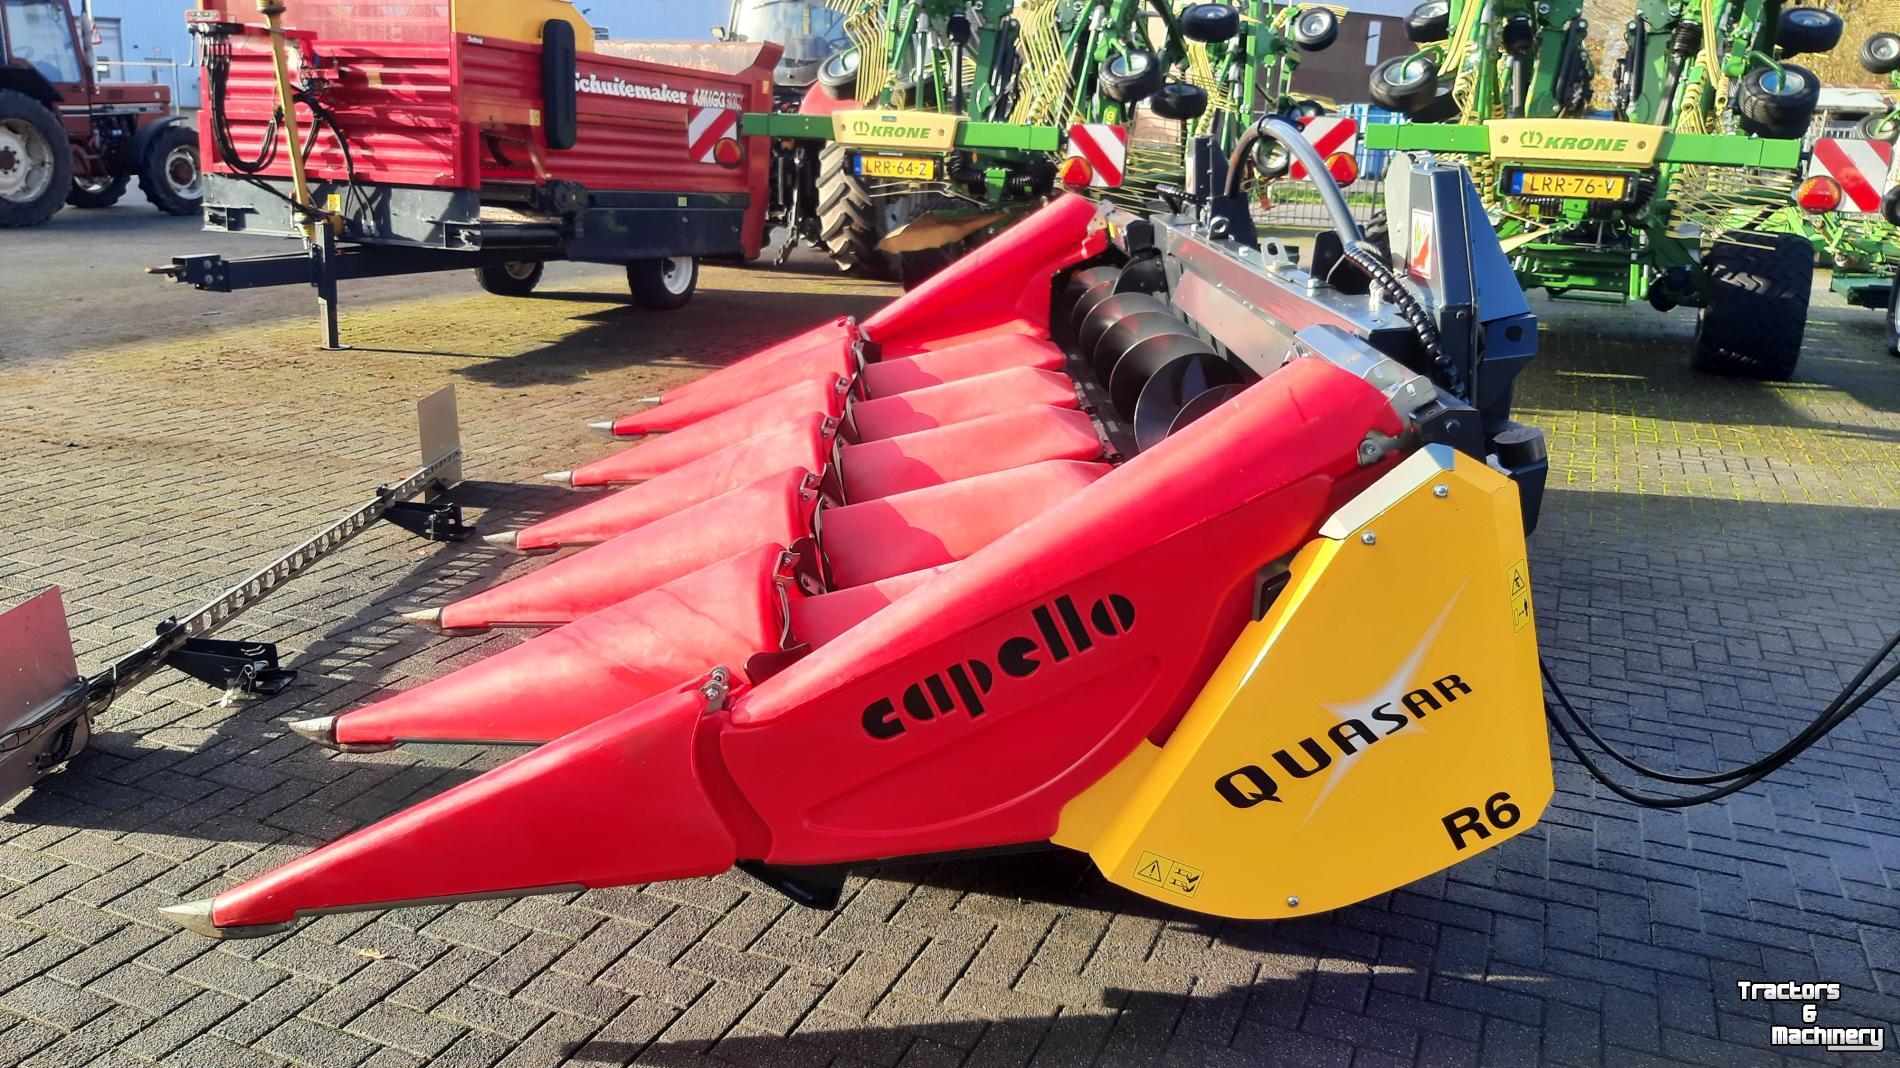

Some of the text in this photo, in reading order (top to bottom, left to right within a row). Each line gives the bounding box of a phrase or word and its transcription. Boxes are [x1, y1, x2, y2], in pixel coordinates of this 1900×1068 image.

[692, 88, 725, 107] AMIGO
[870, 125, 931, 139] KRONE
[1544, 136, 1628, 151] KRONE
[865, 159, 927, 176] LRR-64-Z
[1530, 176, 1615, 195] LRR-76-V
[861, 594, 1135, 740] capello
[1214, 674, 1473, 809] QUASAR
[1441, 791, 1521, 851] R6
